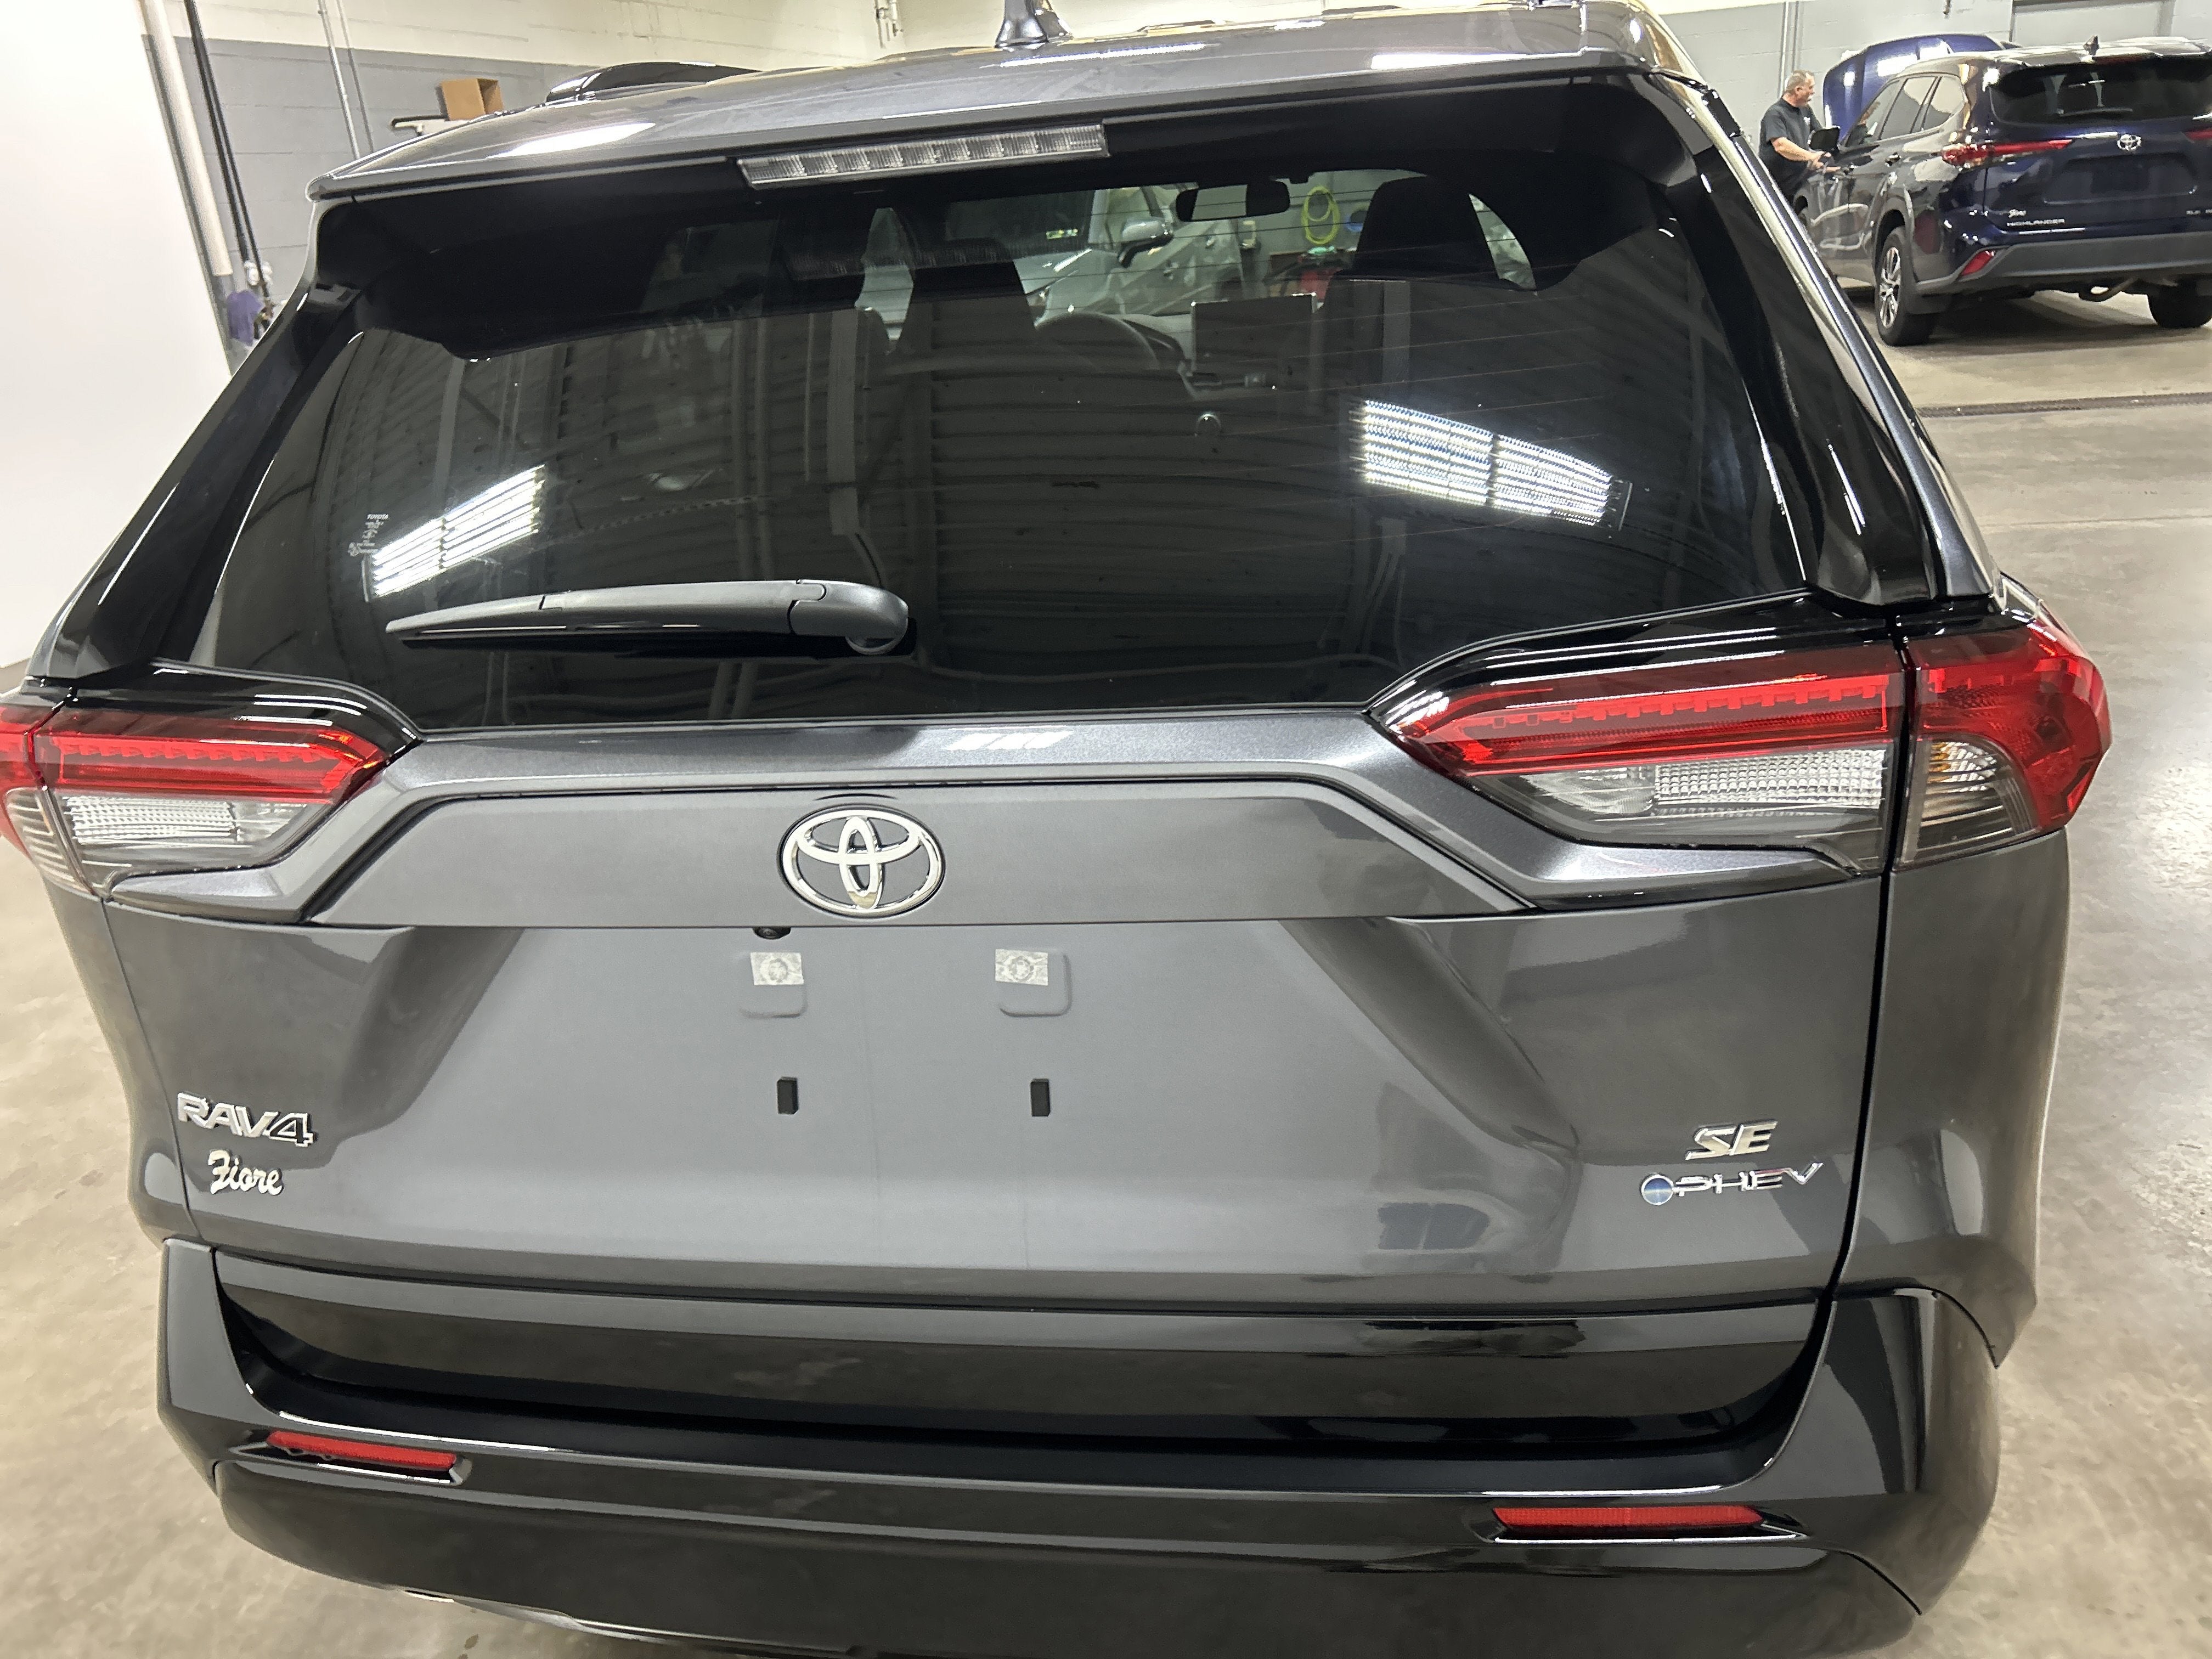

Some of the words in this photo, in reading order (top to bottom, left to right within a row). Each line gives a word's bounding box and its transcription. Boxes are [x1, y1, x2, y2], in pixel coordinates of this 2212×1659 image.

[177, 1092, 314, 1147] RAV4
[1685, 1120, 1778, 1160] SE
[208, 1150, 282, 1195] Fiore
[1673, 1162, 1824, 1197] PHEV
